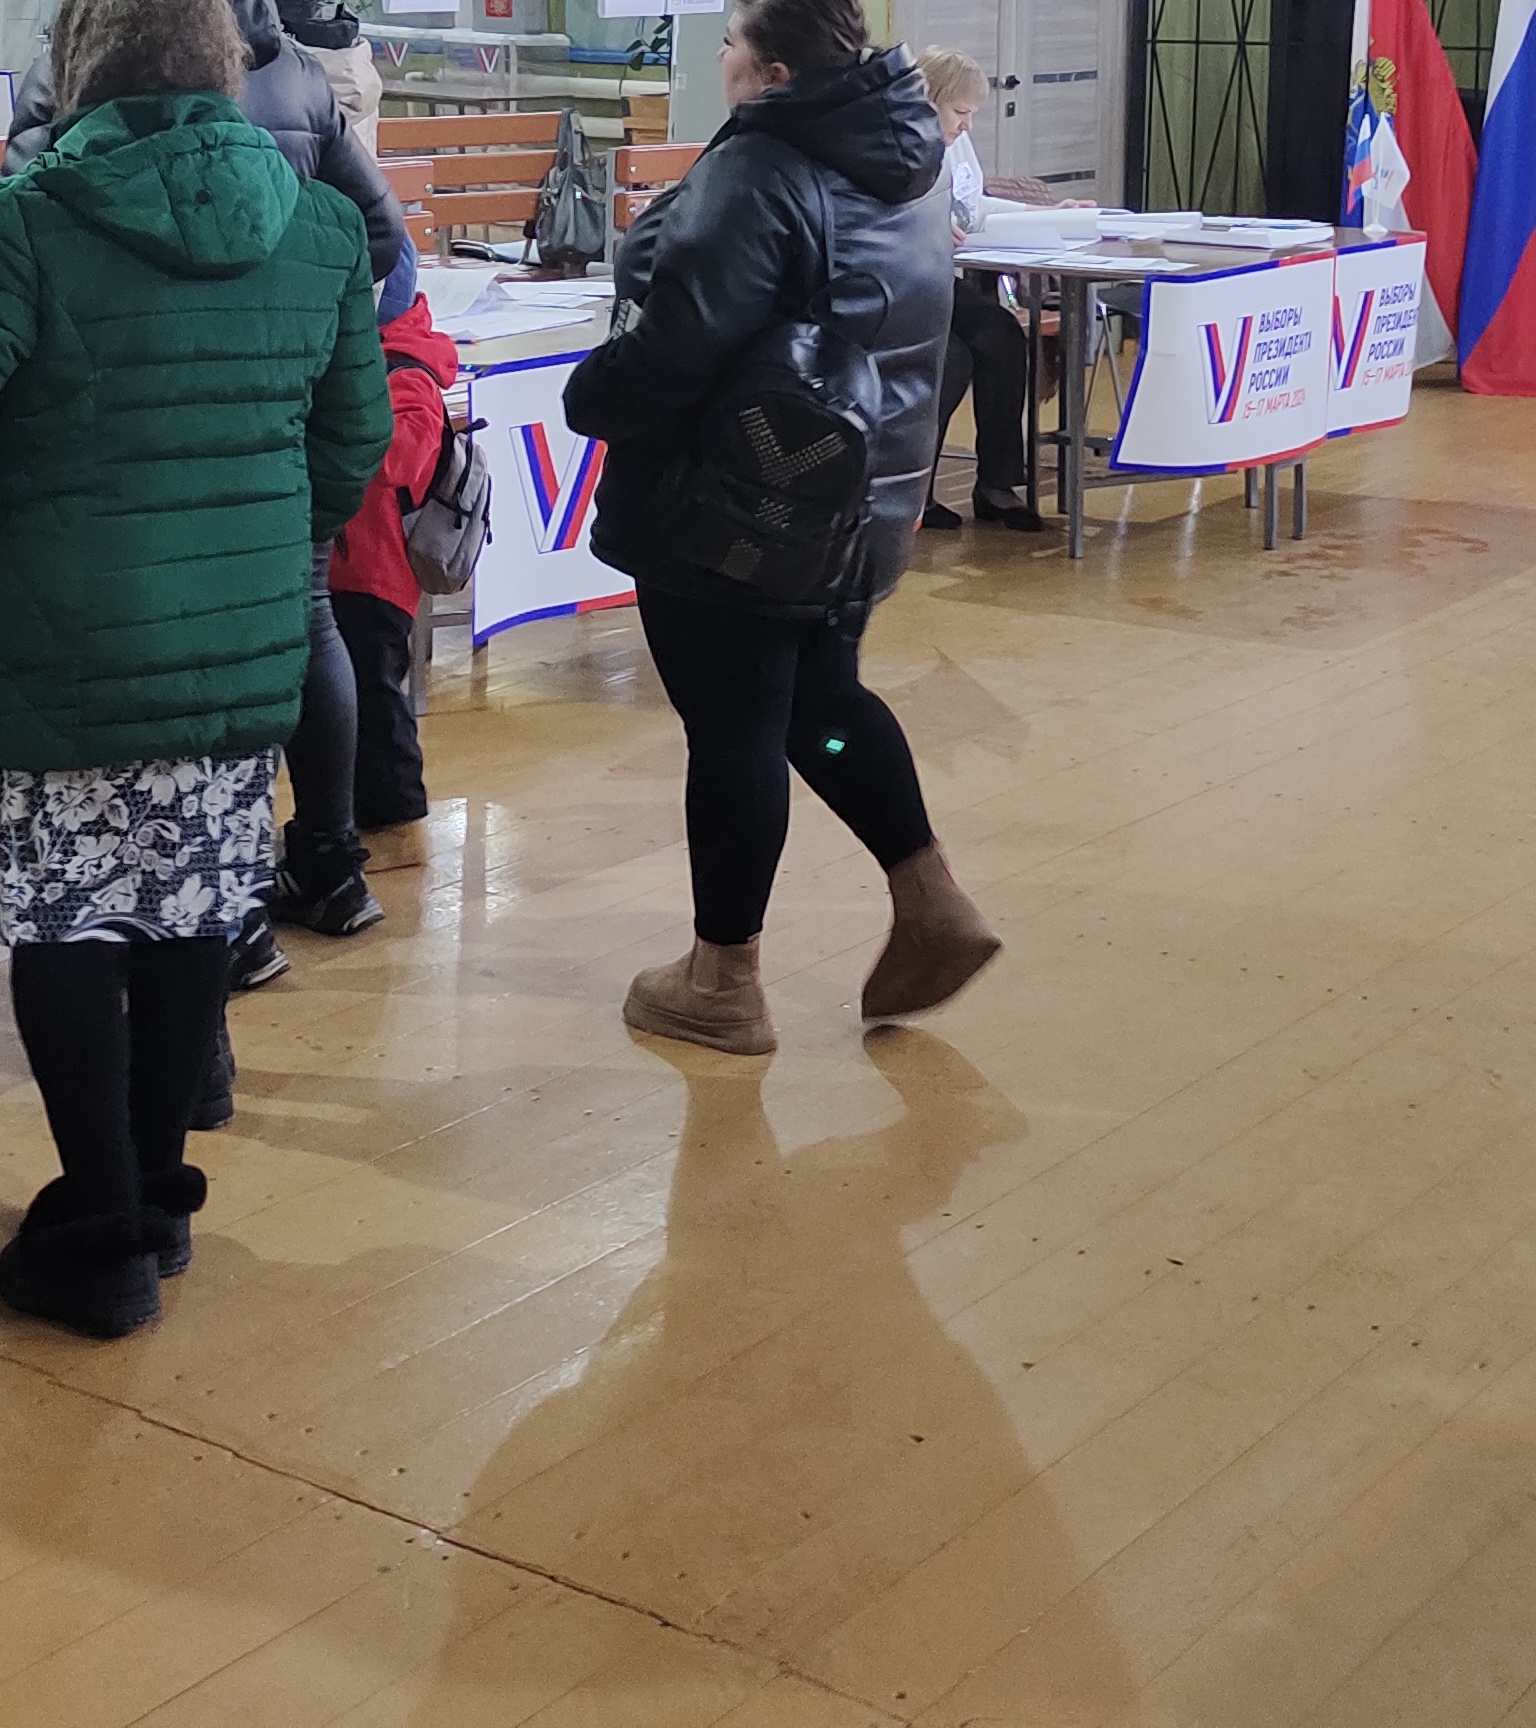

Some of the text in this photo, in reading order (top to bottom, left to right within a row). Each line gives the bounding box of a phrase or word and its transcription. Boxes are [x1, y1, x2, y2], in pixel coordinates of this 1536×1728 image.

[1379, 282, 1417, 308] ВЫБОРЫ
[1258, 306, 1304, 335] ВЫБОРЫ
[1252, 330, 1313, 364] ПРЕЗИДЕНТА
[1367, 337, 1407, 364] РОССИИ
[1247, 364, 1291, 394] РОССИИ
[1266, 391, 1291, 414] МАРТА
